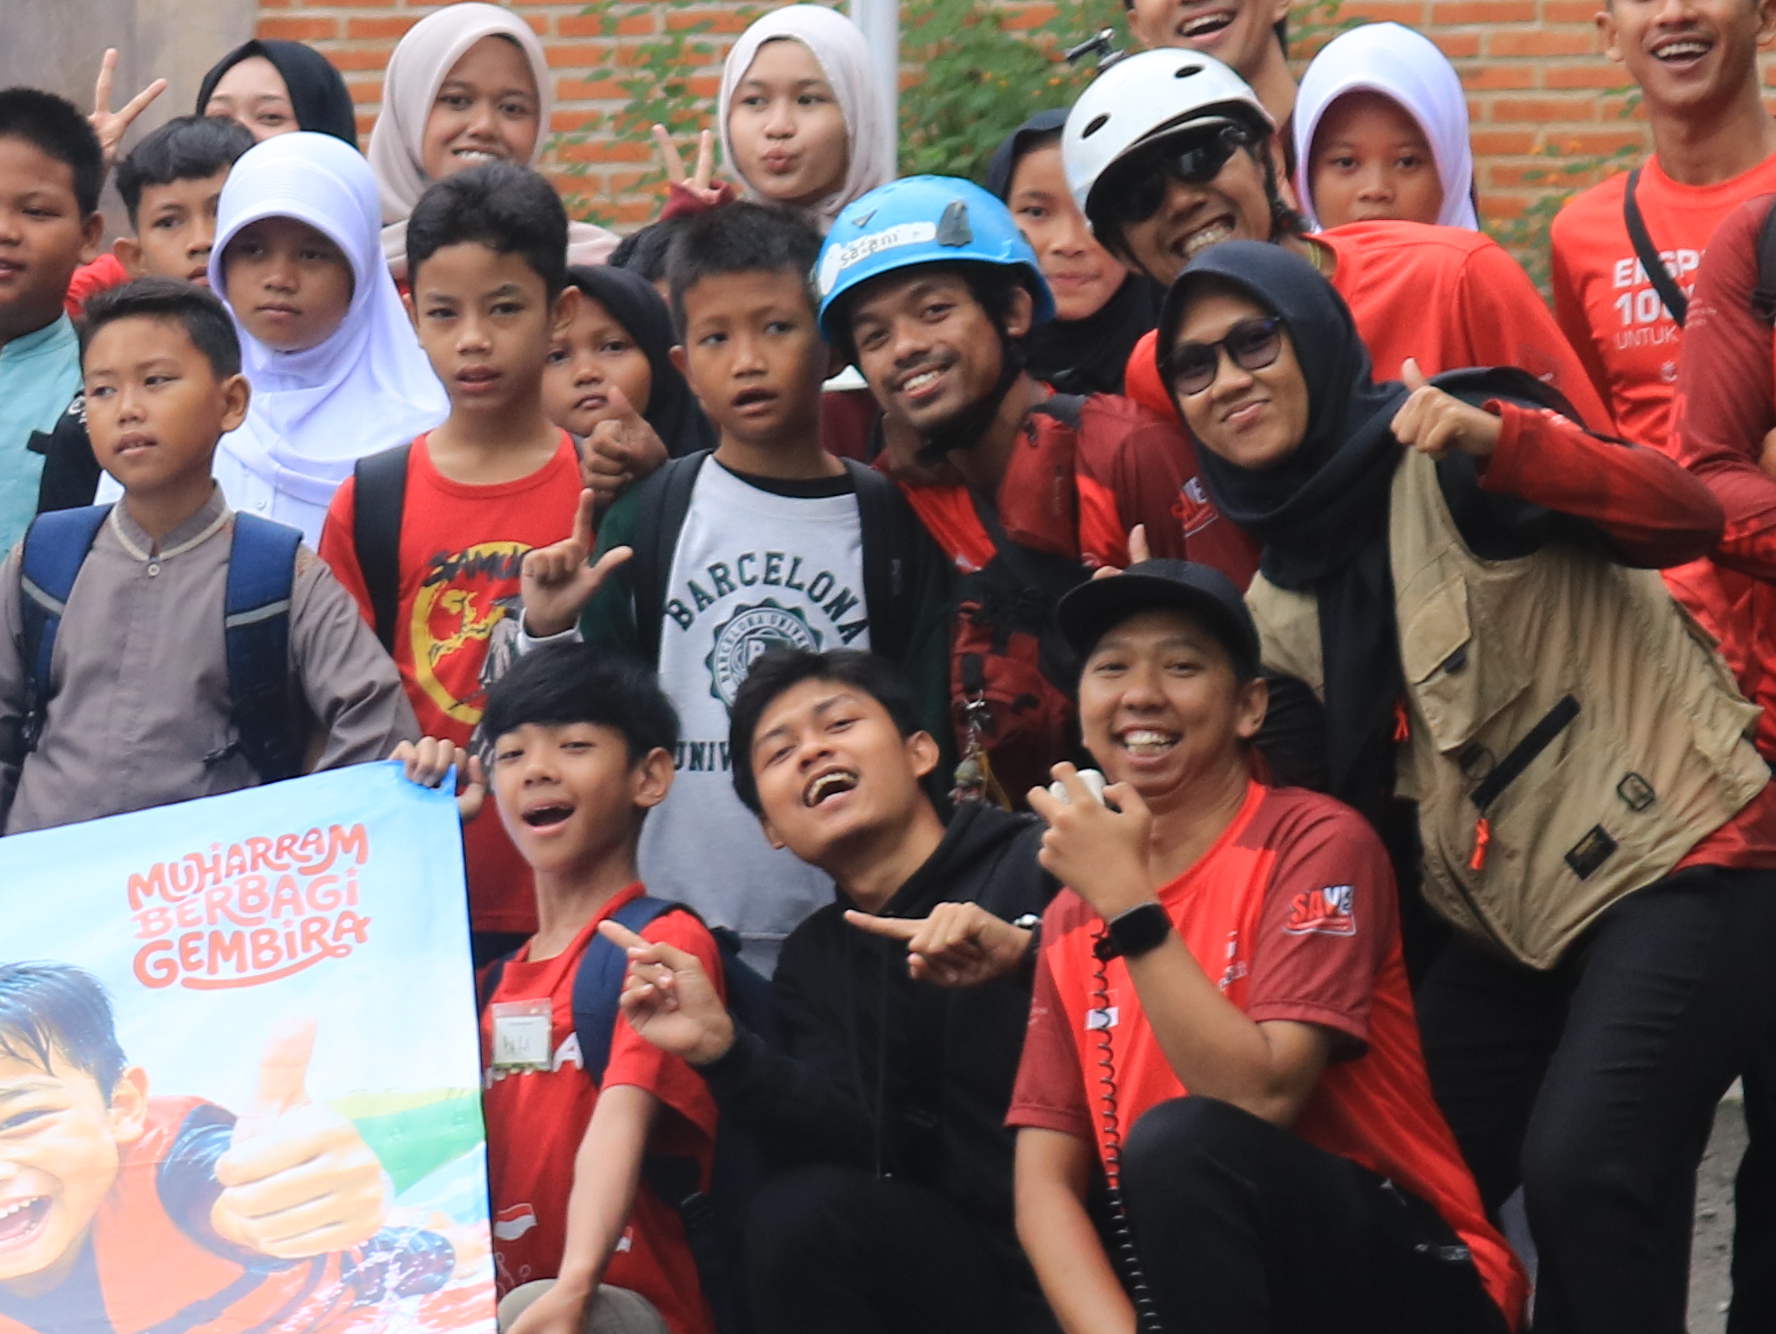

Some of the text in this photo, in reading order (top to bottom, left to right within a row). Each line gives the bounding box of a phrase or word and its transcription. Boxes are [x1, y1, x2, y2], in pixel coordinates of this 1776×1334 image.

[1615, 324, 1679, 349] UNTUK
[666, 550, 870, 647] BARCELONA
[127, 822, 369, 911] MUHARRAM
